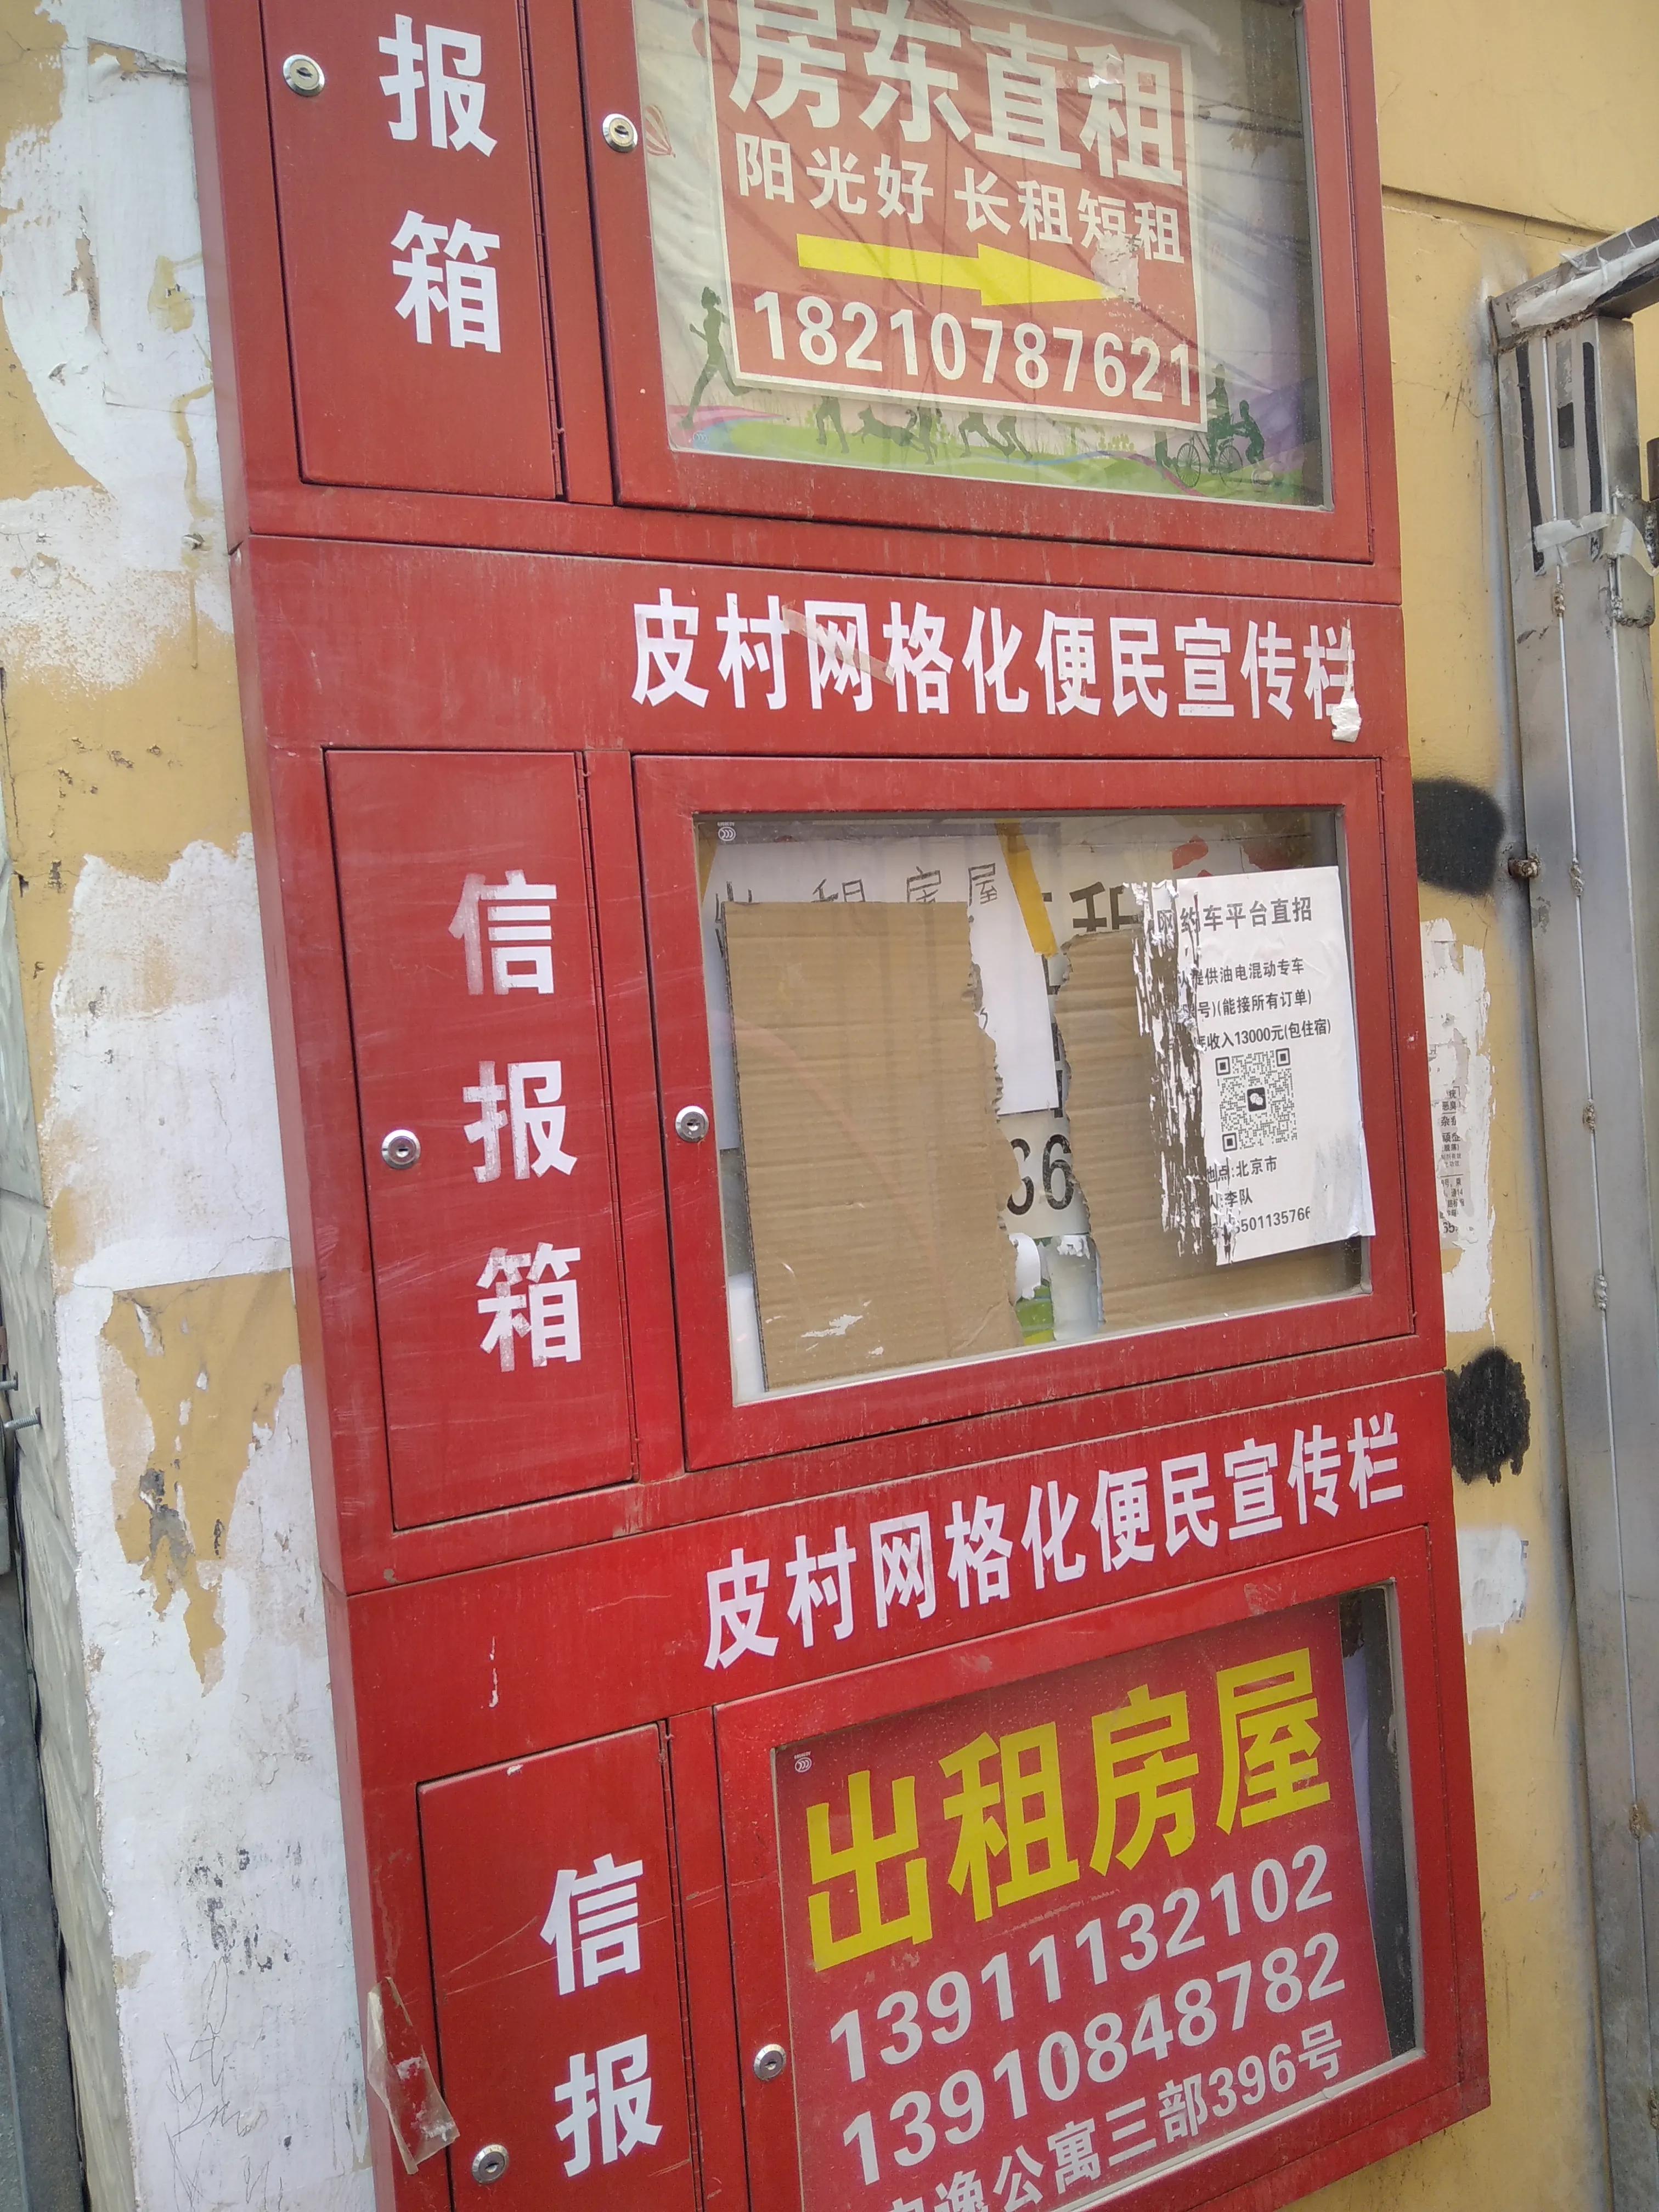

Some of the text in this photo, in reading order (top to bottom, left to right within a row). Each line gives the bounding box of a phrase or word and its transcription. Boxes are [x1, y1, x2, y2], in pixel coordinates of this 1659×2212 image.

[379, 14, 501, 353] 报箱
[729, 0, 1183, 187] 房东直租
[735, 133, 1184, 264] 阳光好 长租短租
[753, 291, 1192, 407] 18210787621
[631, 588, 1358, 720] 皮村网格化便民宣传栏
[448, 870, 582, 1373] 信报箱
[703, 1412, 1404, 1670] 皮村网格化便民宣传栏
[806, 1647, 1330, 1973] 出租房屋
[540, 1853, 663, 2177] 信报
[830, 1844, 1333, 2082] 13911132102
[843, 1932, 1346, 2186] 13910848782
